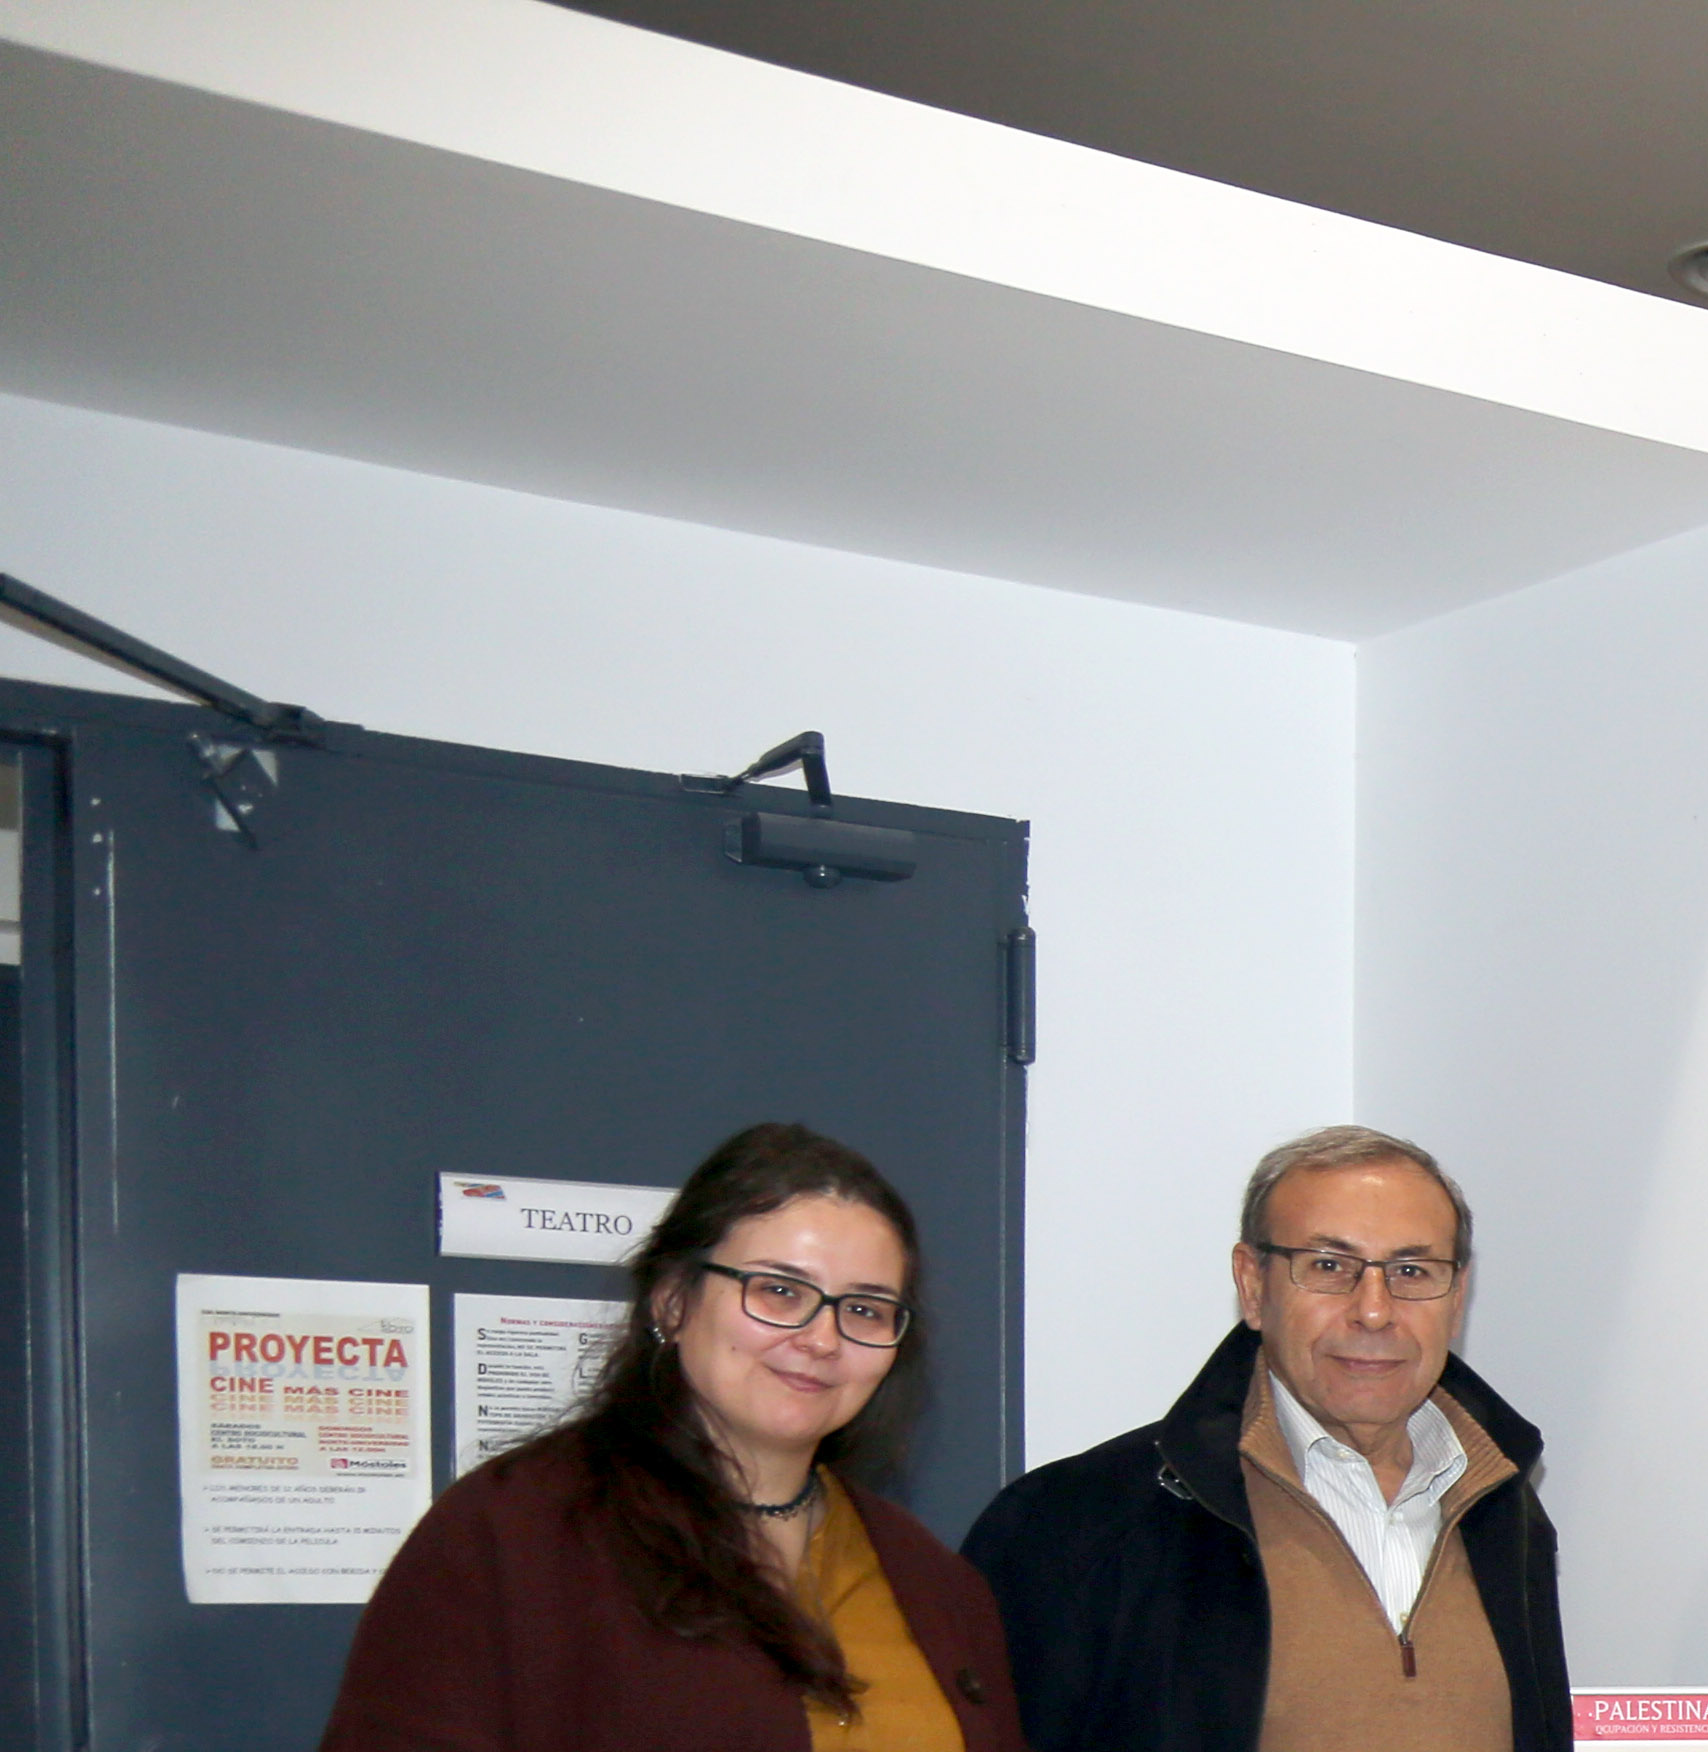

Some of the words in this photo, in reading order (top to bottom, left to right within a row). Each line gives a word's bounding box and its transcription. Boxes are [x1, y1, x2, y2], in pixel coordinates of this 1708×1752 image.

[520, 1208, 633, 1236] TEATRO
[208, 1332, 407, 1367] PROYECTA
[210, 1376, 273, 1393] CINE
[284, 1386, 339, 1395] MÁS
[348, 1389, 407, 1397] CINE
[349, 1460, 406, 1469] Móstoles
[1595, 1724, 1649, 1734] OCUPACIÓN
[1651, 1724, 1657, 1733] Y
